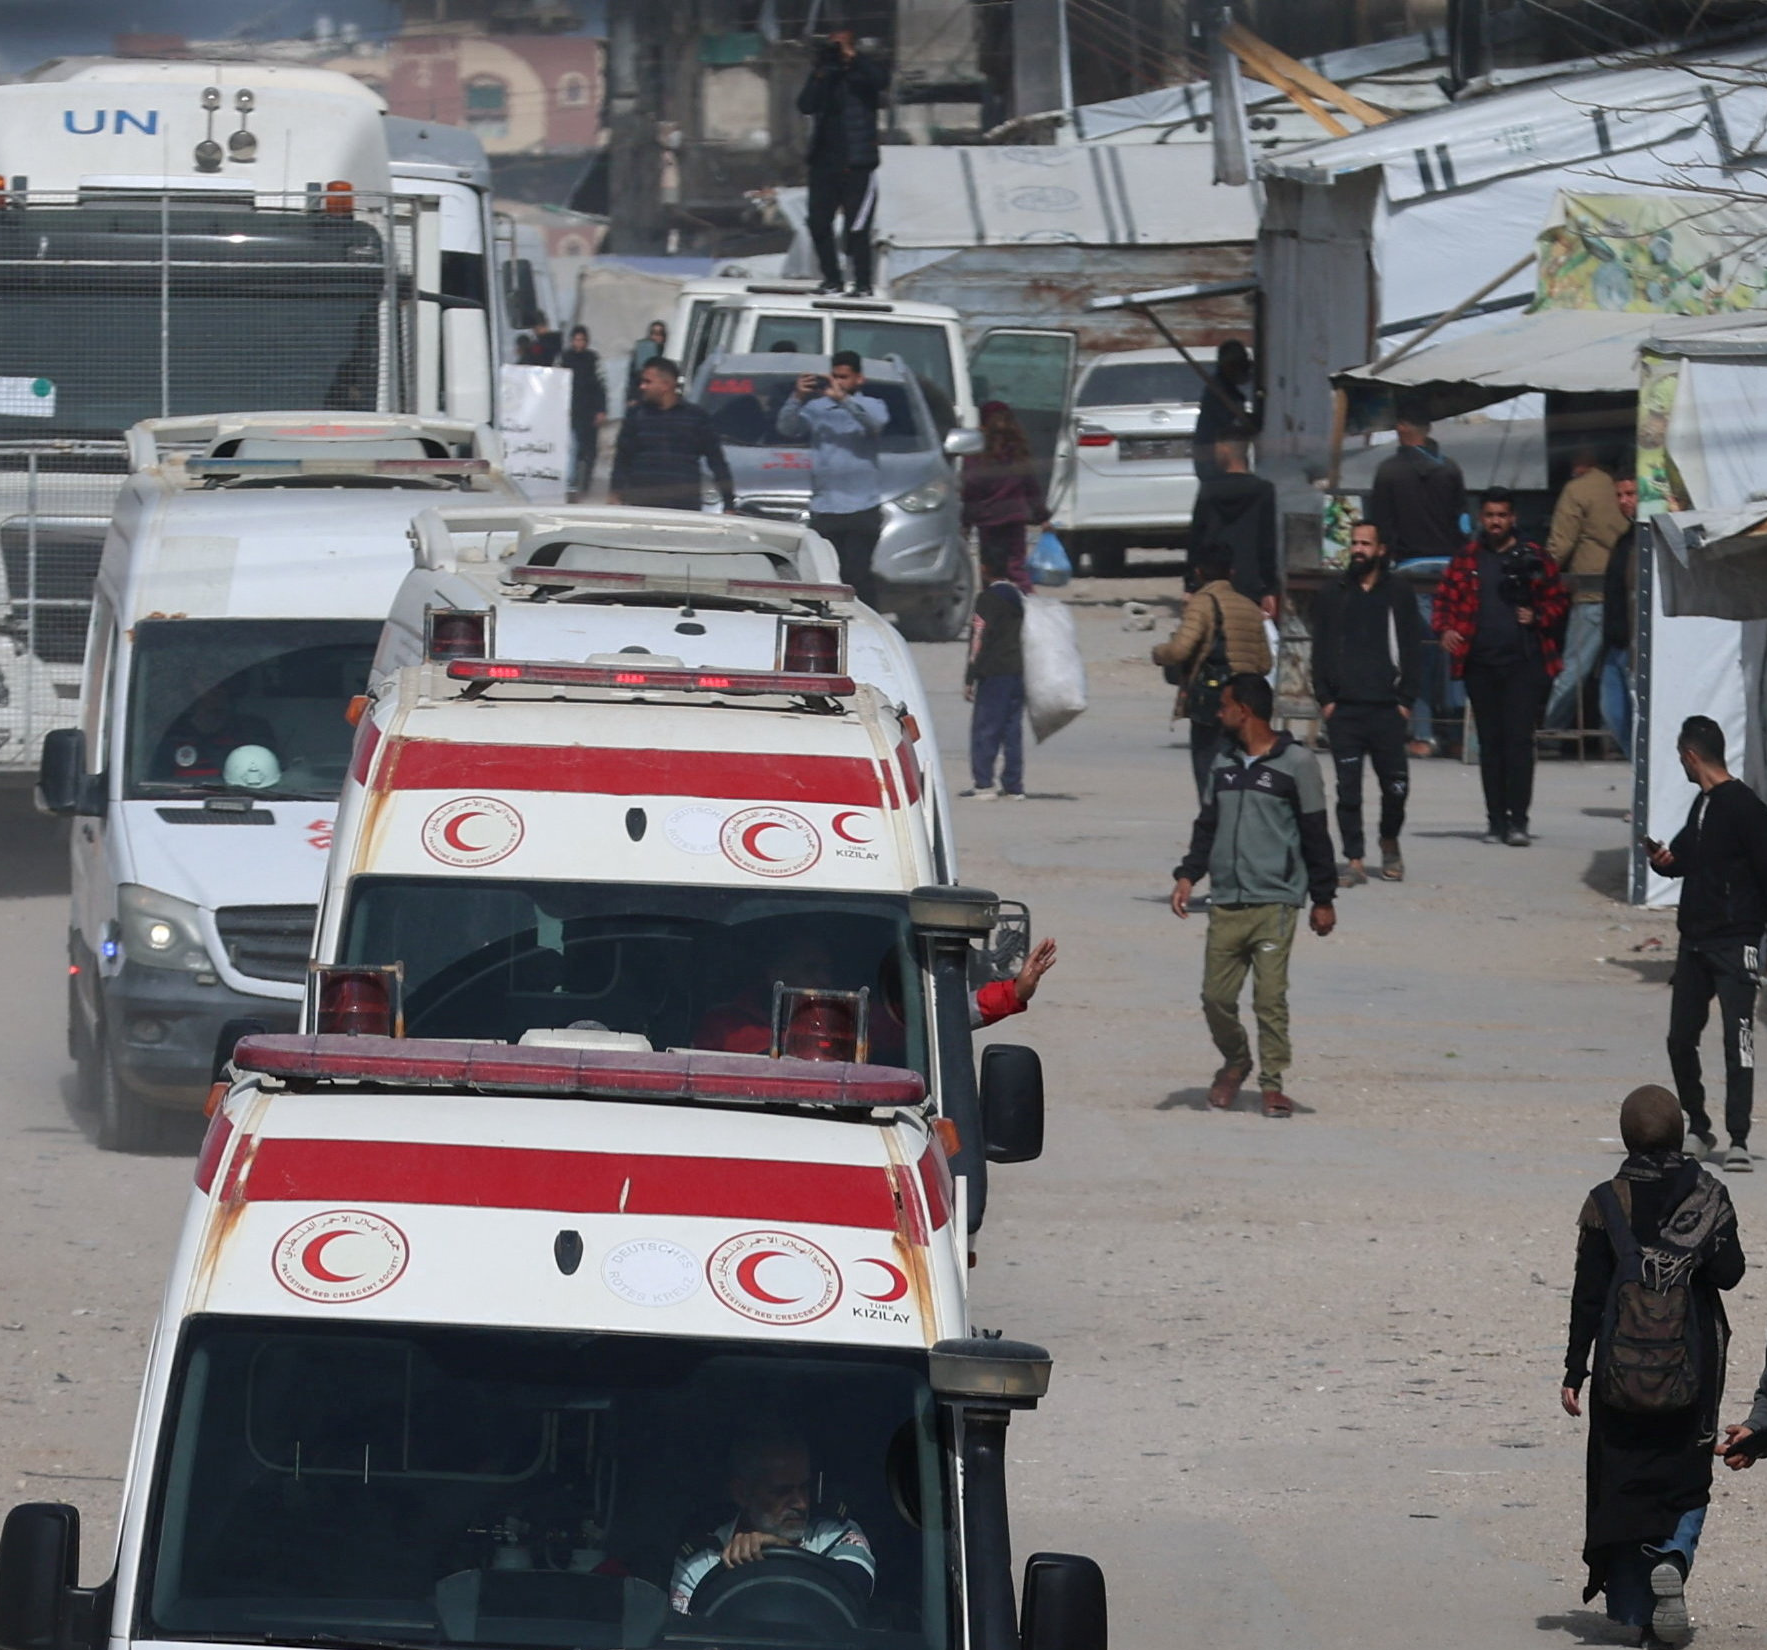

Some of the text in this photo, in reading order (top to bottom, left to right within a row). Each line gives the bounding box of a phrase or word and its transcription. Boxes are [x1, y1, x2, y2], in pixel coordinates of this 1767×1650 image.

[64, 109, 159, 136] UN
[669, 806, 727, 824] DEUTSCHE
[835, 849, 880, 861] KIZILAY
[611, 1241, 694, 1270] DEUTSCHES
[608, 1270, 647, 1302] ROTES
[652, 1275, 696, 1303] KREUZ
[852, 1307, 911, 1325] KIZILAY
